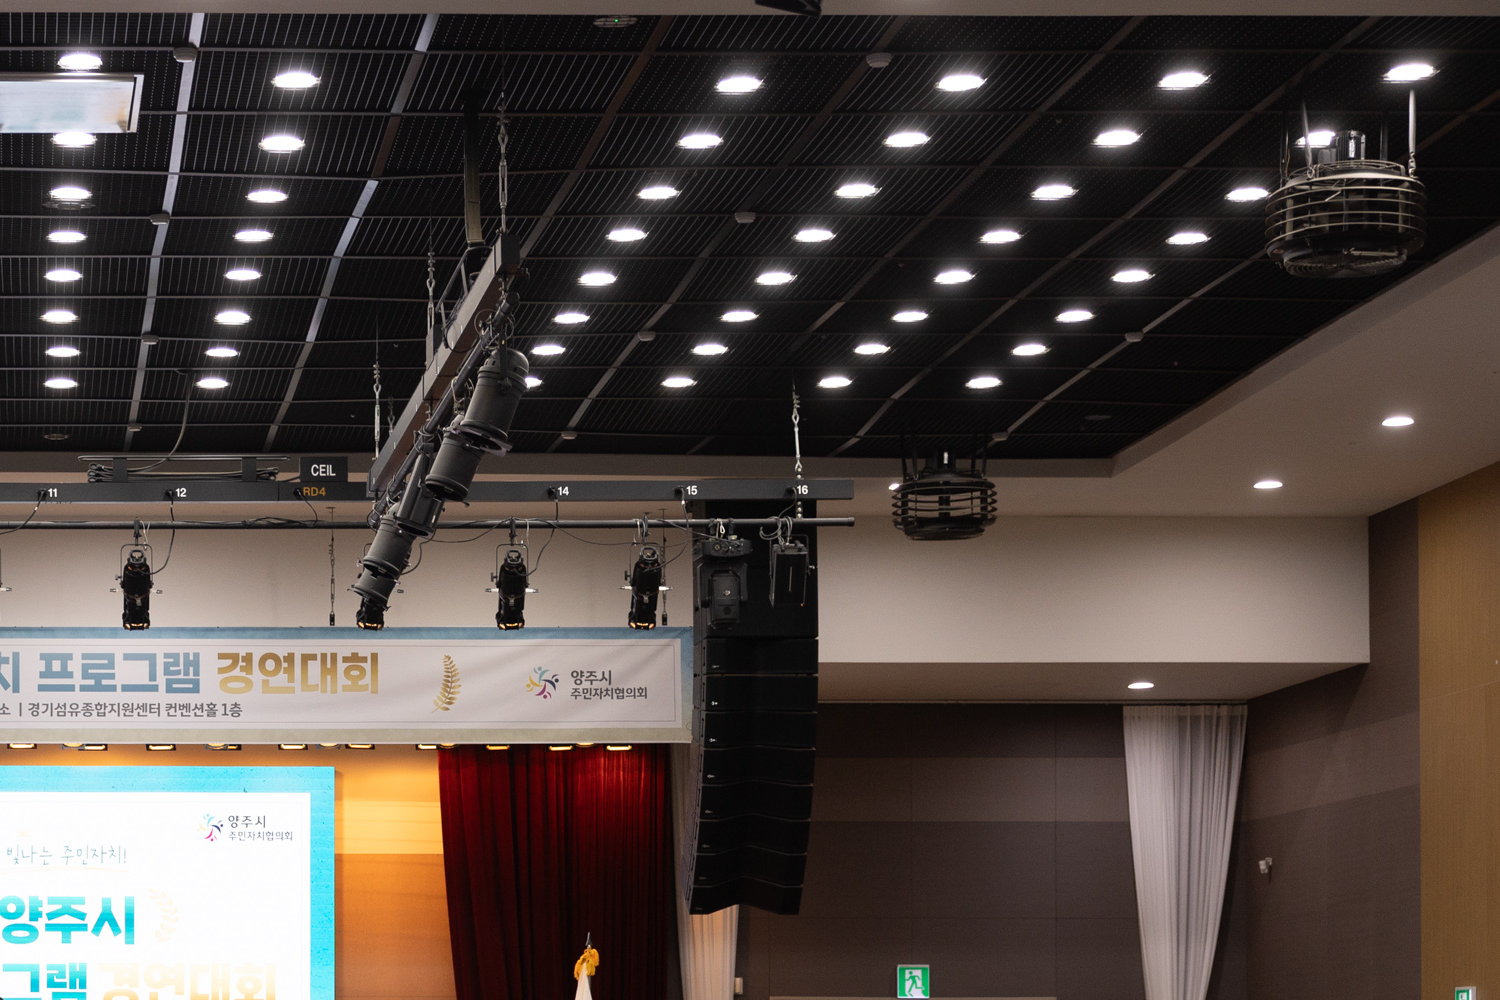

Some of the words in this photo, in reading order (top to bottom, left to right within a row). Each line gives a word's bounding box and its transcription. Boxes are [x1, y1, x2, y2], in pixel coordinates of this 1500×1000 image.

[310, 464, 337, 476] CEIL
[47, 487, 58, 497] 11
[175, 487, 187, 497] 12
[303, 486, 326, 496] RD4
[557, 486, 570, 496] 14
[686, 485, 698, 495] 15
[796, 485, 809, 495] 16
[37, 652, 201, 694] 프로그램
[217, 651, 379, 695] 경연대회
[570, 670, 612, 686] 양주시
[570, 687, 648, 699] 주민자치협의회
[27, 702, 161, 718] 경기섬유종합지원센터
[165, 702, 219, 718] 컨벤션홀
[221, 702, 243, 718] 1층
[228, 815, 267, 829] 양주시
[228, 830, 293, 842] 주민자치협의회
[6, 844, 53, 866] 빛나는
[60, 843, 127, 866] 주민자치!
